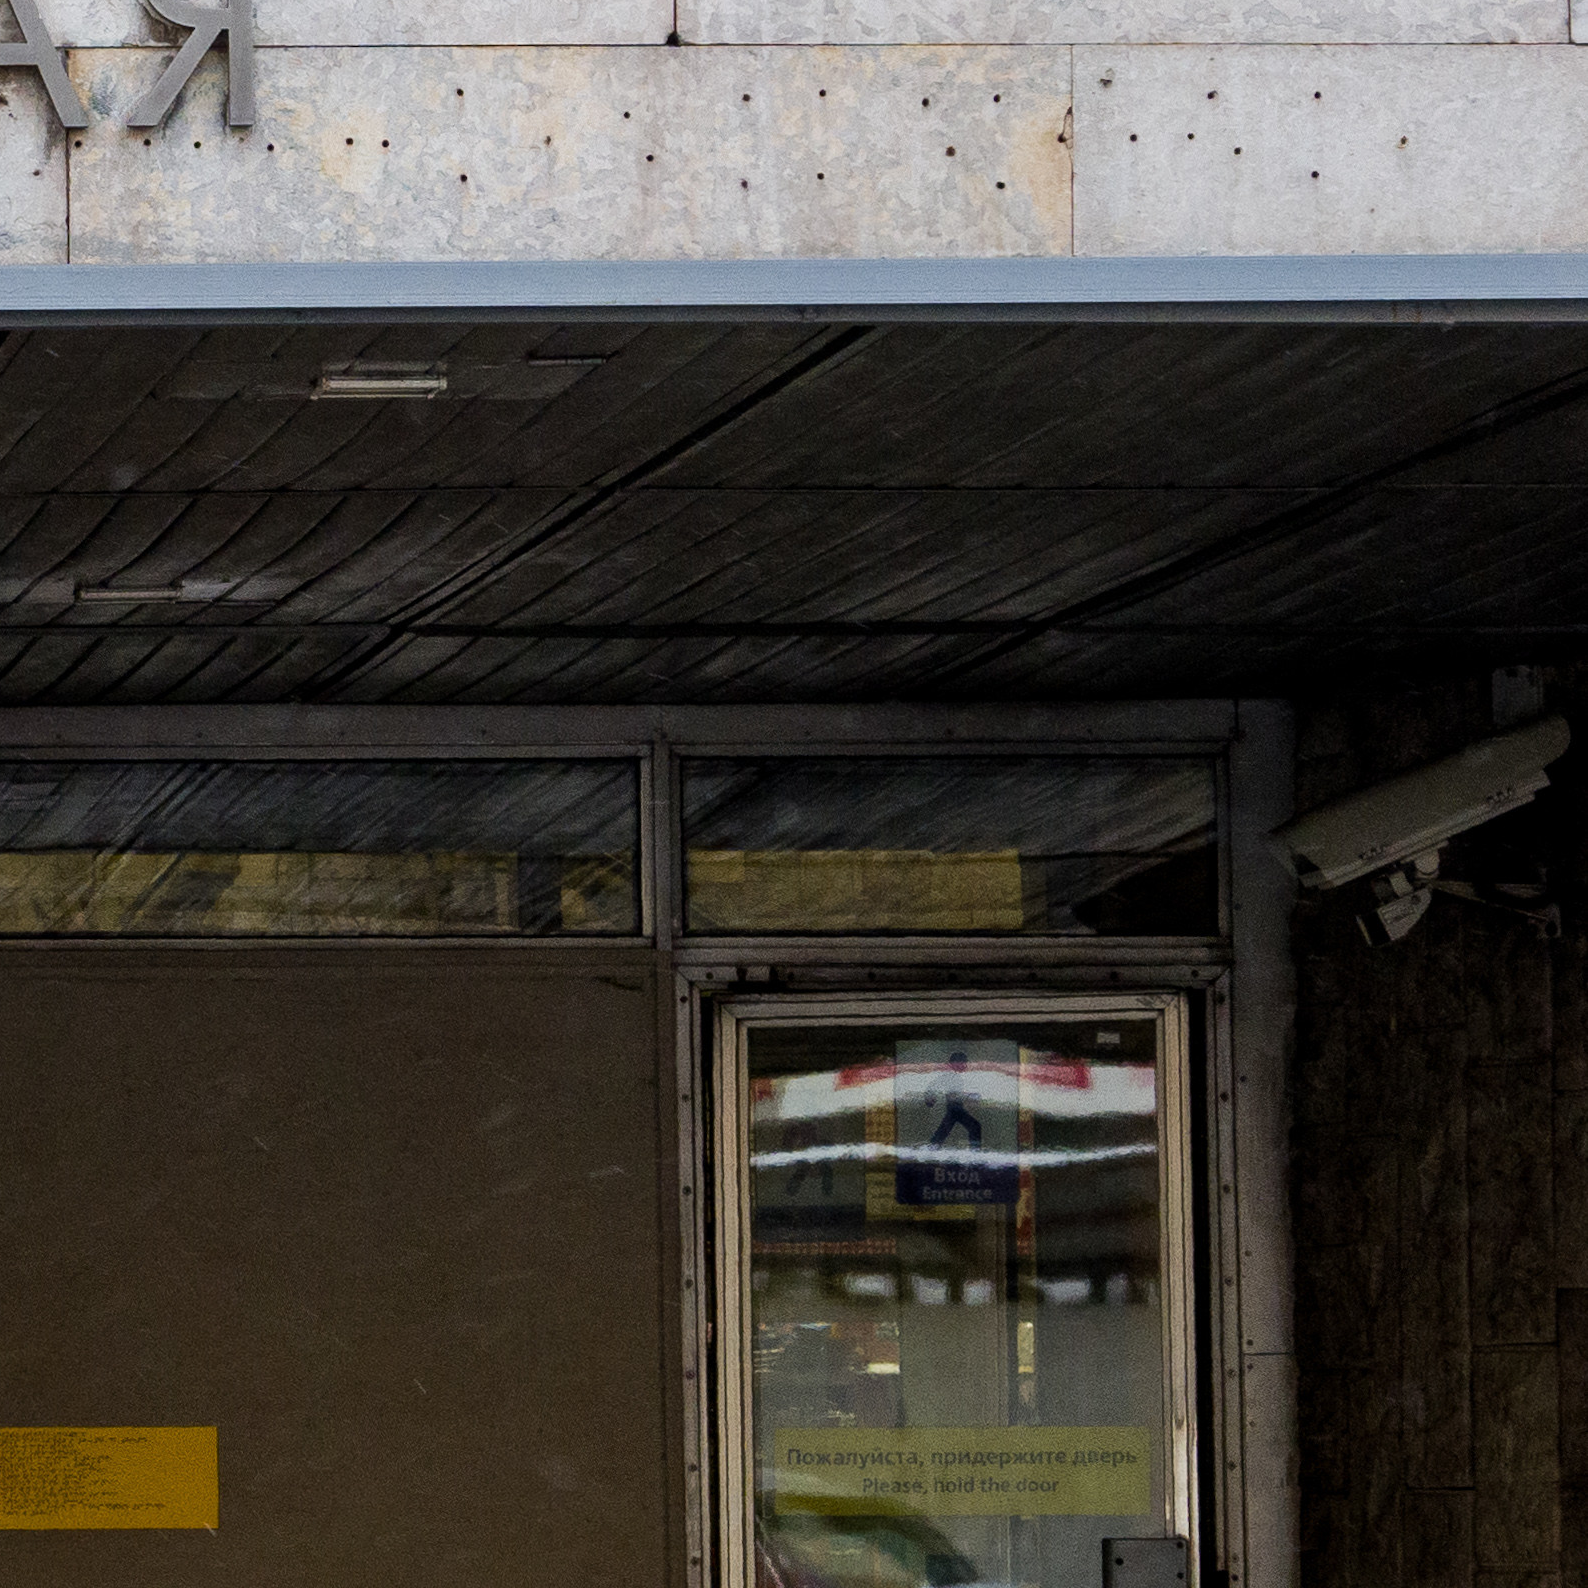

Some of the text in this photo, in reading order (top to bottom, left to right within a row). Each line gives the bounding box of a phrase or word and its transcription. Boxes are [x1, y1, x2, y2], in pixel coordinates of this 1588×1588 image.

[933, 1168, 980, 1185] Вход
[922, 1186, 993, 1201] Entrance
[786, 1448, 1138, 1470] Пожалуйста, придержите дверь
[862, 1477, 1060, 1495] Please, hold the door
